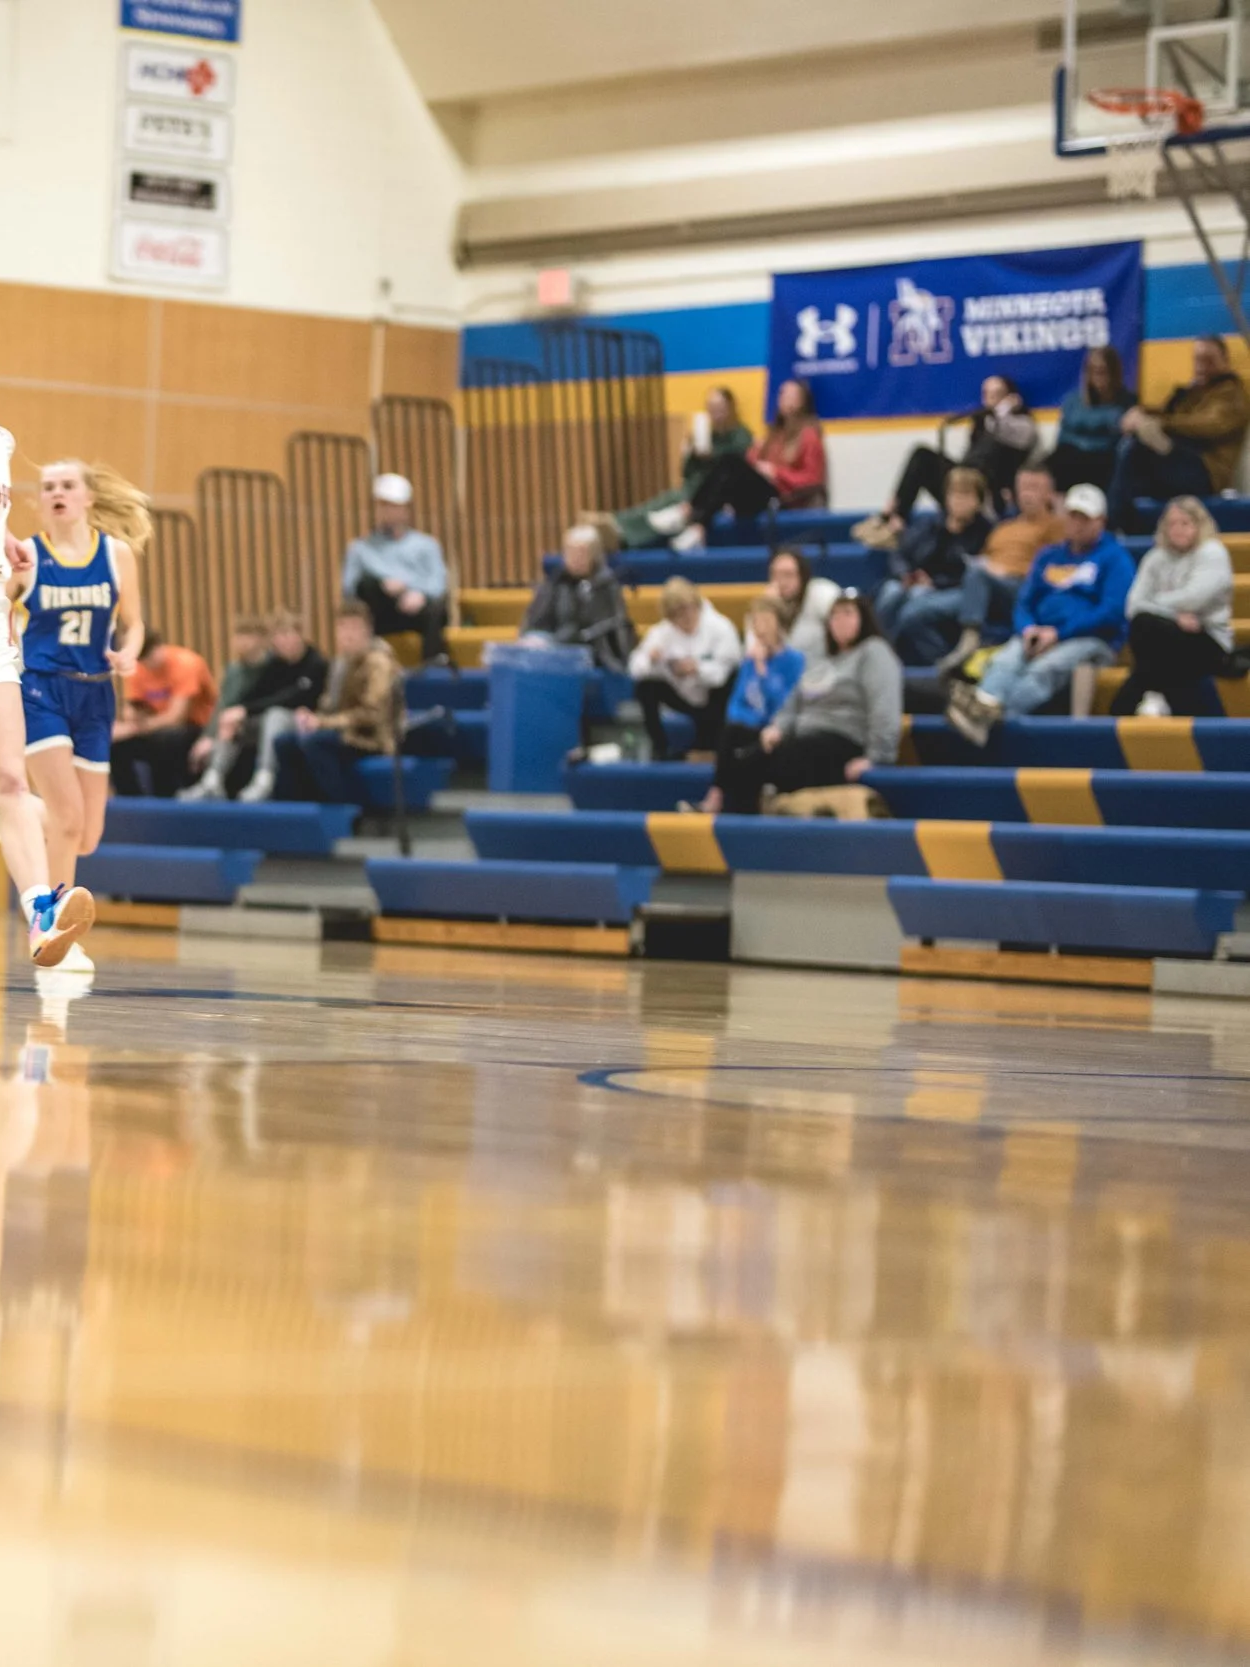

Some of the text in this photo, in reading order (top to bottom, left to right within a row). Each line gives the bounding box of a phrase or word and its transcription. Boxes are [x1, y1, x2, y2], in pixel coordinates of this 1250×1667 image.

[960, 316, 1110, 358] VIKINGS
[40, 582, 111, 610] VIKINGS
[59, 610, 93, 645] 21
